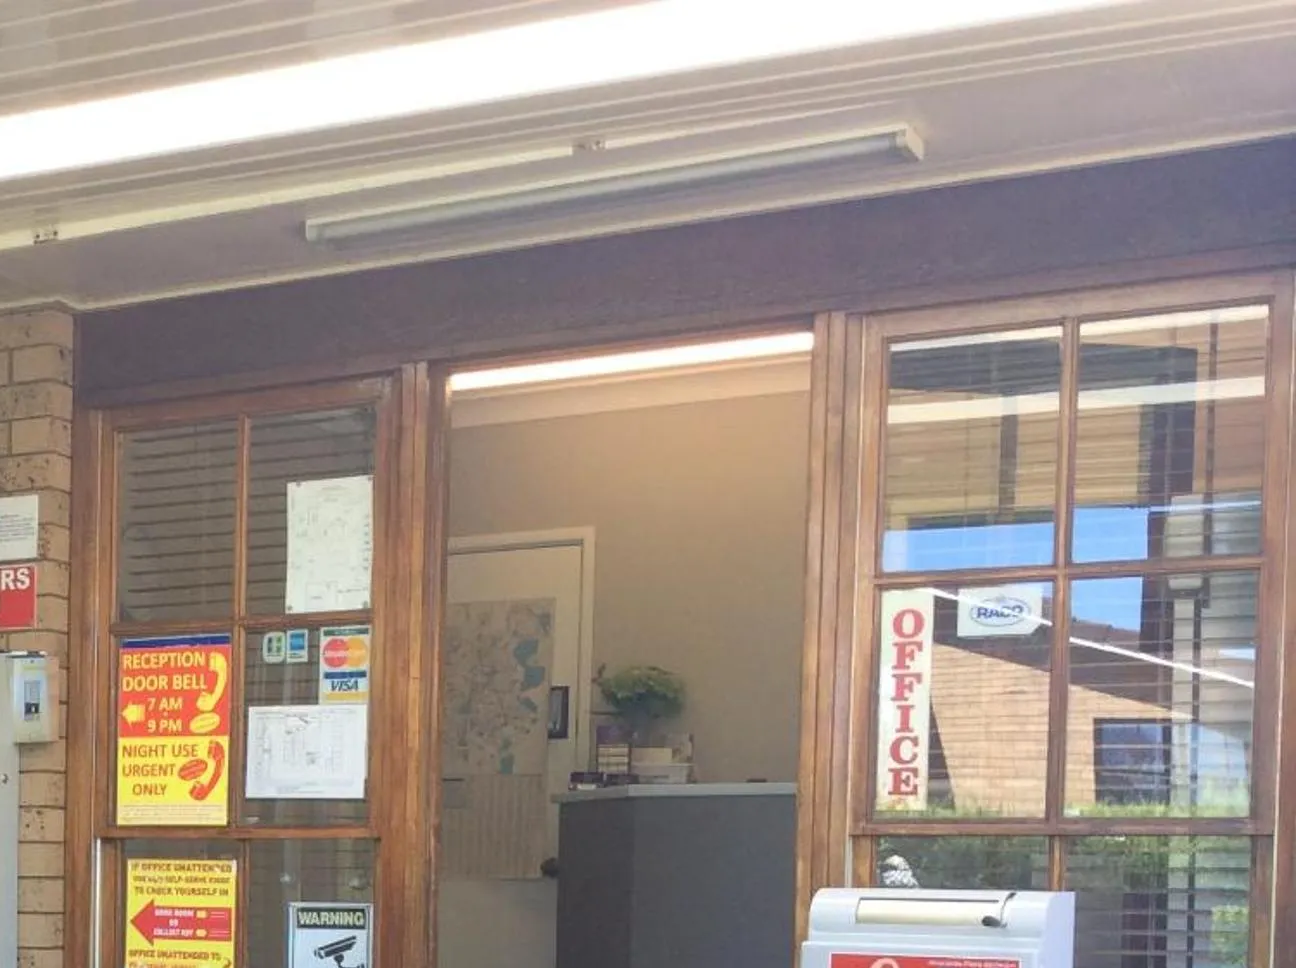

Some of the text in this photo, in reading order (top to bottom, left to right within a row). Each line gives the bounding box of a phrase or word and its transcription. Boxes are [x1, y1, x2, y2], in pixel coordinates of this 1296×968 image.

[122, 651, 205, 670] RECEPTION
[122, 674, 208, 692] DOOR BELL
[329, 680, 360, 692] VISA
[147, 696, 184, 711] 7 AM
[887, 608, 925, 796] OFFICE
[147, 719, 183, 733] 9 PM
[122, 744, 199, 759] NIGHT USE
[122, 763, 176, 778] URGENT
[132, 783, 168, 797] ONLY
[142, 863, 172, 872] OFFICE
[298, 911, 365, 927] WARNING
